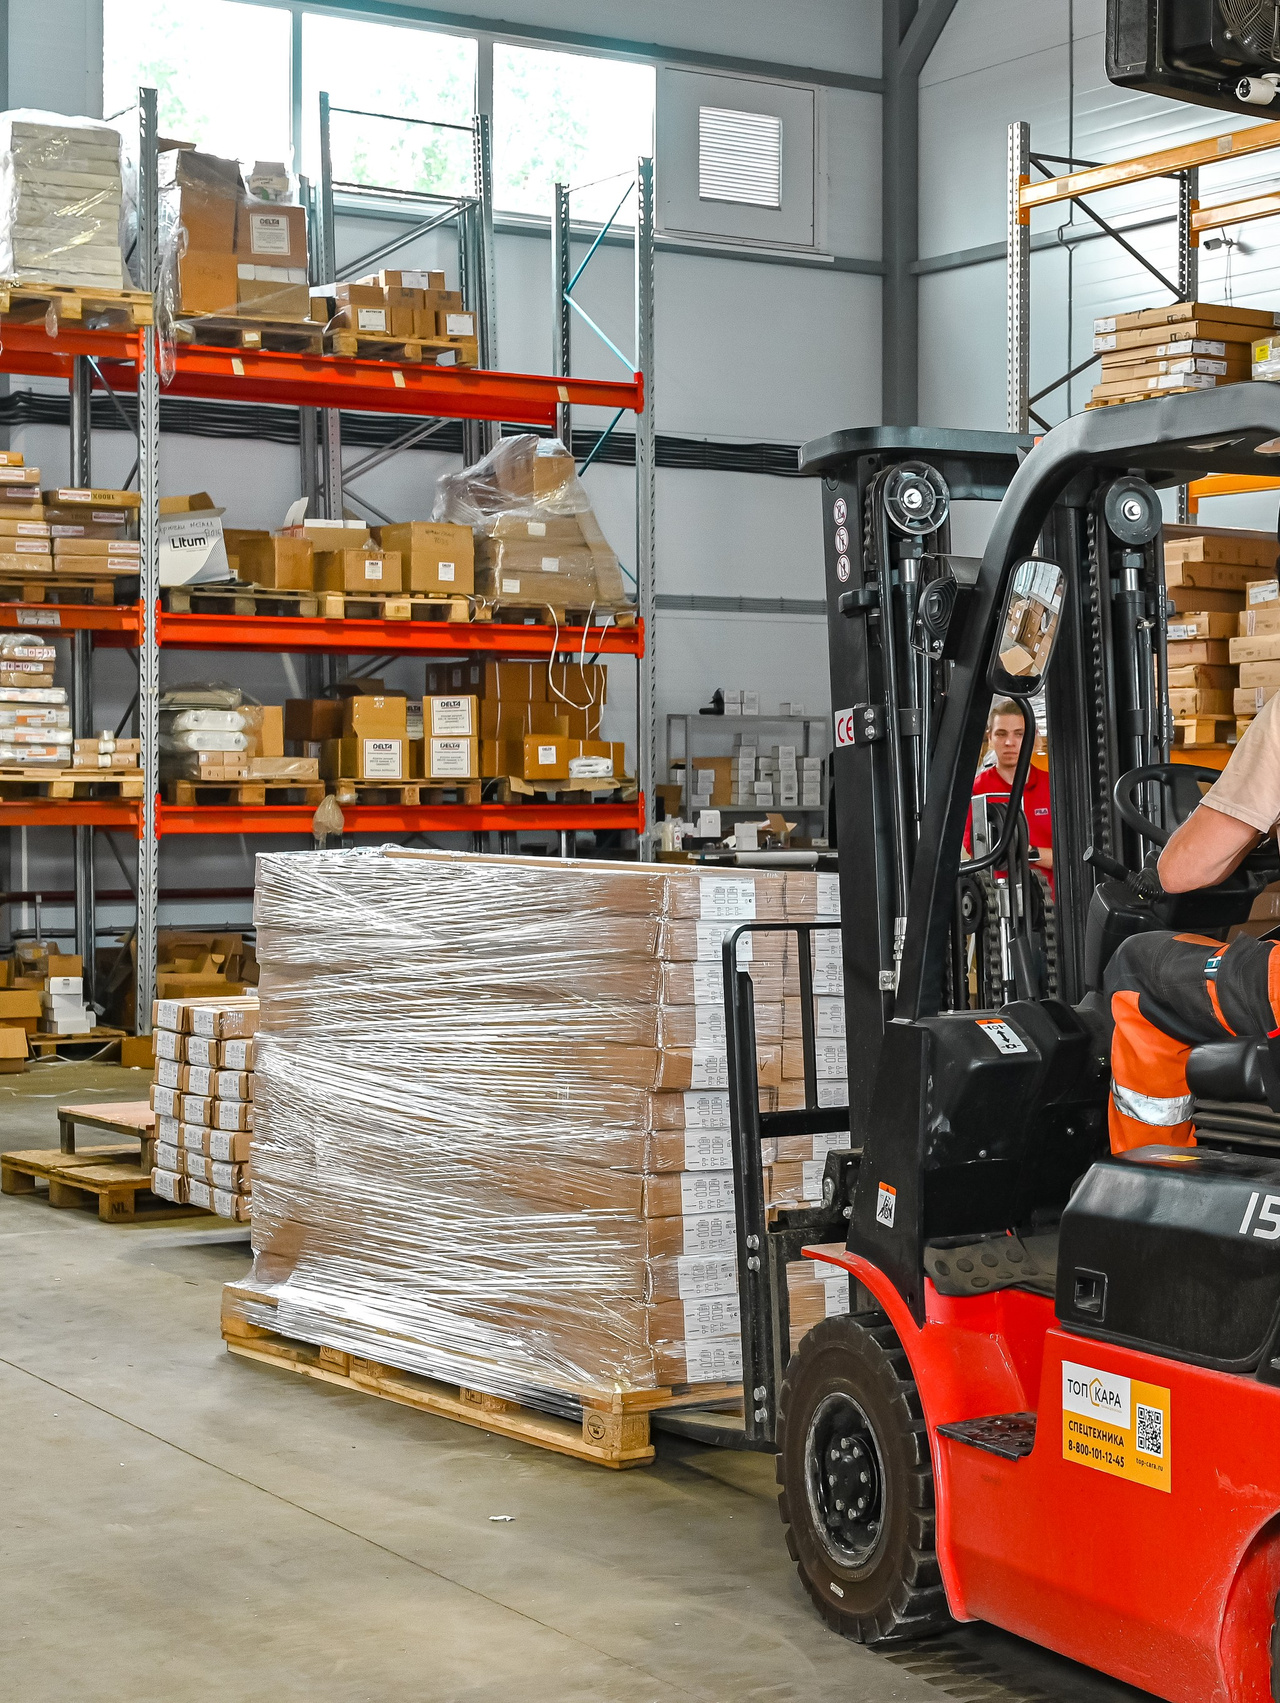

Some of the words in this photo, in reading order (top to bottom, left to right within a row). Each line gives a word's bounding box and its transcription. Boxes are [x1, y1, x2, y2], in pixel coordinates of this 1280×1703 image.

[171, 537, 206, 549] Litum
[837, 715, 853, 743] CE
[1067, 1379, 1088, 1398] ТОП
[1094, 1386, 1122, 1408] КАРА
[1068, 1420, 1125, 1448] СПЕЦТЕХНИКА
[1068, 1440, 1125, 1468] 8-800-101-12-45
[1135, 1458, 1164, 1472] top-cara.ru
